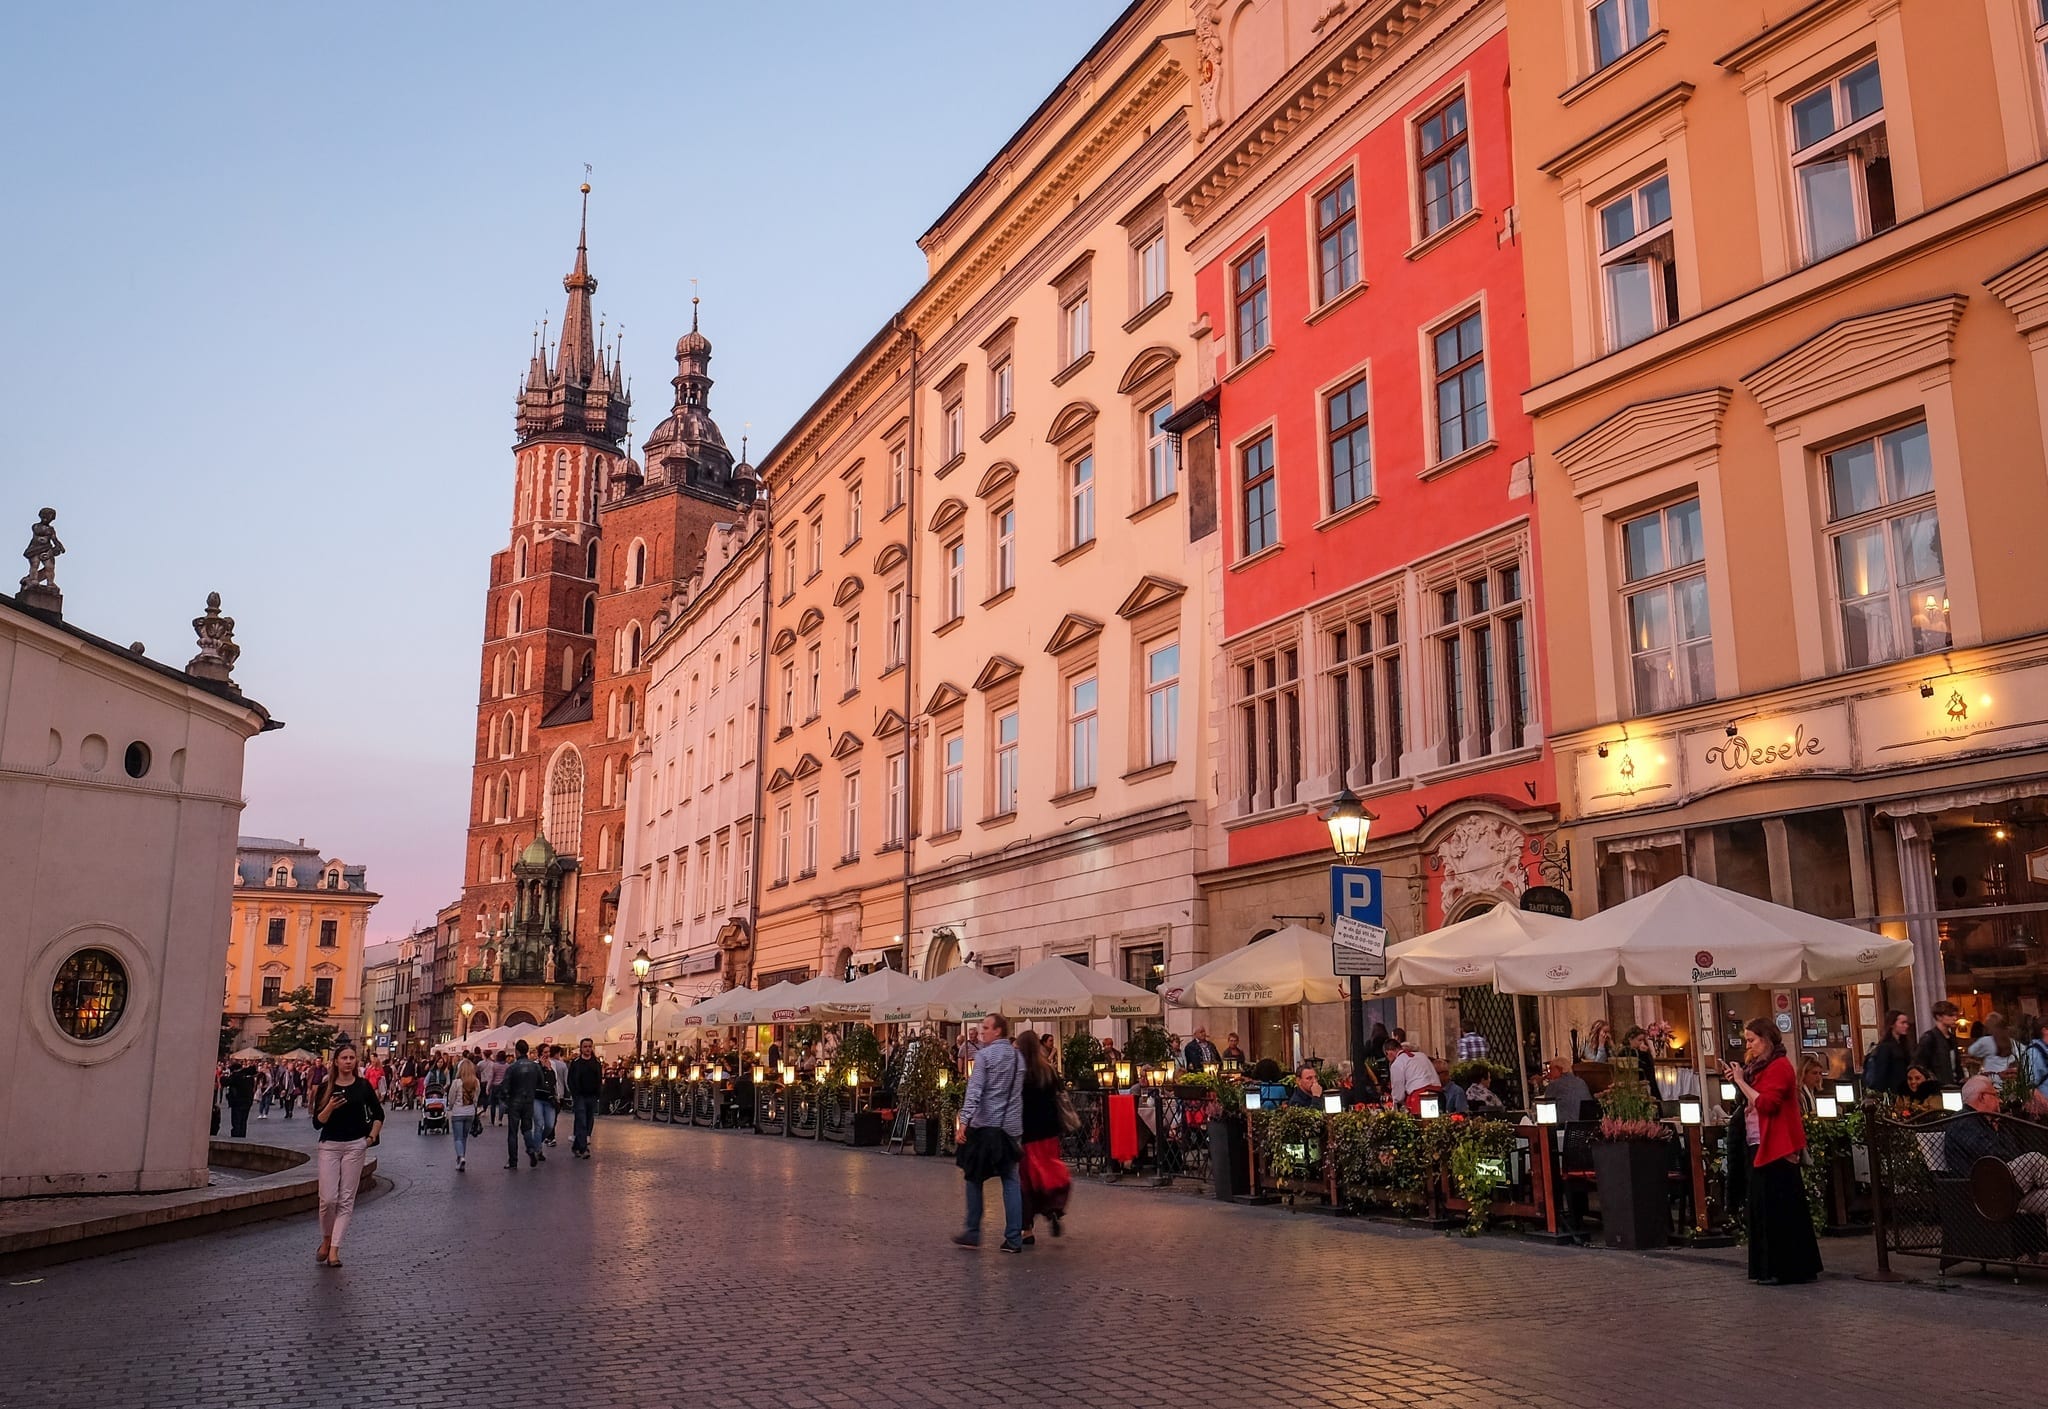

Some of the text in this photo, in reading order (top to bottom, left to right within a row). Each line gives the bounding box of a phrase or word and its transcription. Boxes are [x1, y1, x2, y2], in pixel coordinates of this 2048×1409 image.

[1705, 723, 1826, 772] Wesele
[1343, 873, 1371, 918] P
[1223, 990, 1273, 1001] ZŁOTY PIEC
[1110, 1004, 1142, 1013] Heineken
[884, 1012, 912, 1021] Heineken
[379, 1036, 387, 1046] P
